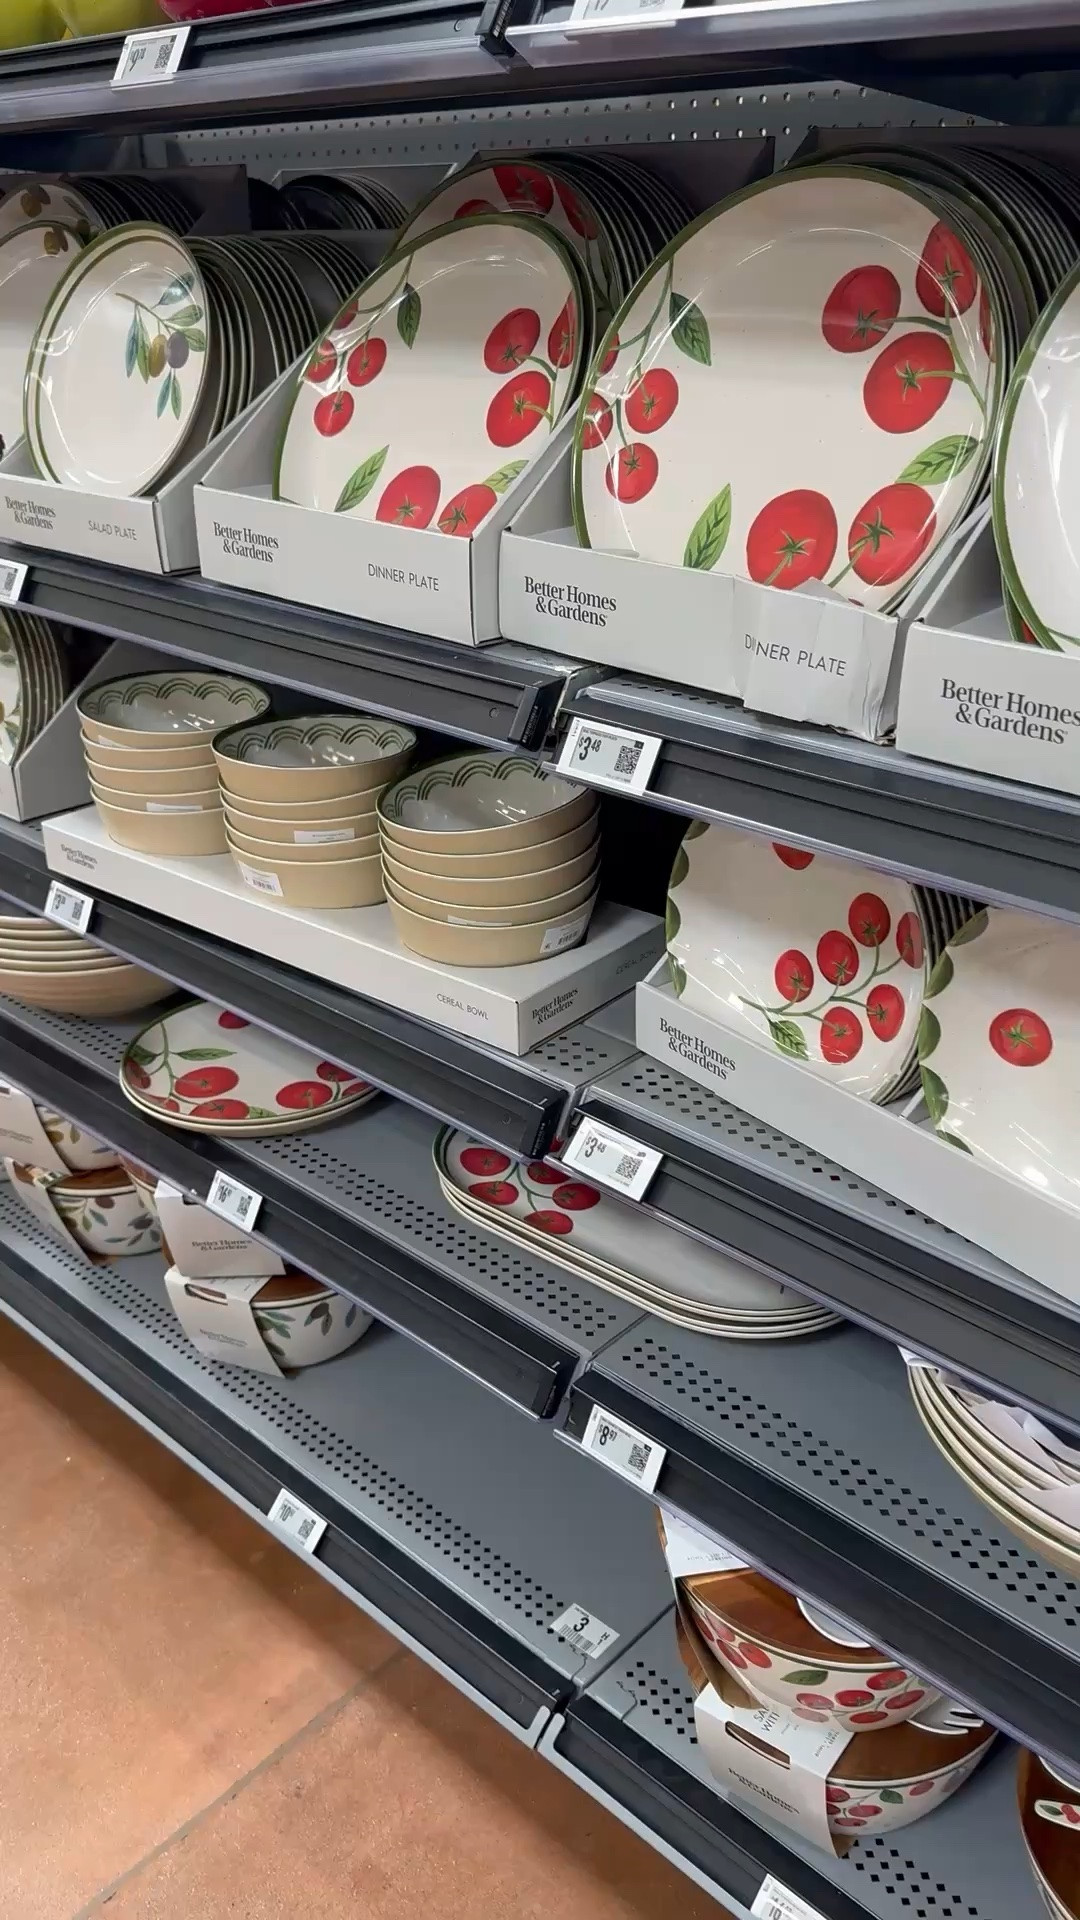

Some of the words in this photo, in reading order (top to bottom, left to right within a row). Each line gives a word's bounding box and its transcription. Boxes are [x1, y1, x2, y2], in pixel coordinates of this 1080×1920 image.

[5, 496, 27, 513] Better
[27, 501, 56, 518] Homes
[88, 520, 113, 536] SALAD
[114, 525, 137, 541] PLATE
[213, 521, 242, 541] Better
[243, 527, 279, 549] Homes
[368, 563, 405, 584] DINNER
[408, 572, 439, 592] PLATE
[524, 575, 565, 601] Better
[566, 584, 617, 612] Homes
[797, 650, 847, 677] PLATE
[940, 678, 1004, 710] Better
[1006, 692, 1080, 727] Homes
[436, 993, 465, 1011] CEREAL
[466, 1004, 489, 1021] BOWL
[532, 1000, 553, 1020] Better
[552, 988, 579, 1007] Homes
[660, 1016, 693, 1047] Better
[694, 1036, 736, 1072] Homes
[573, 1616, 590, 1632] 3
